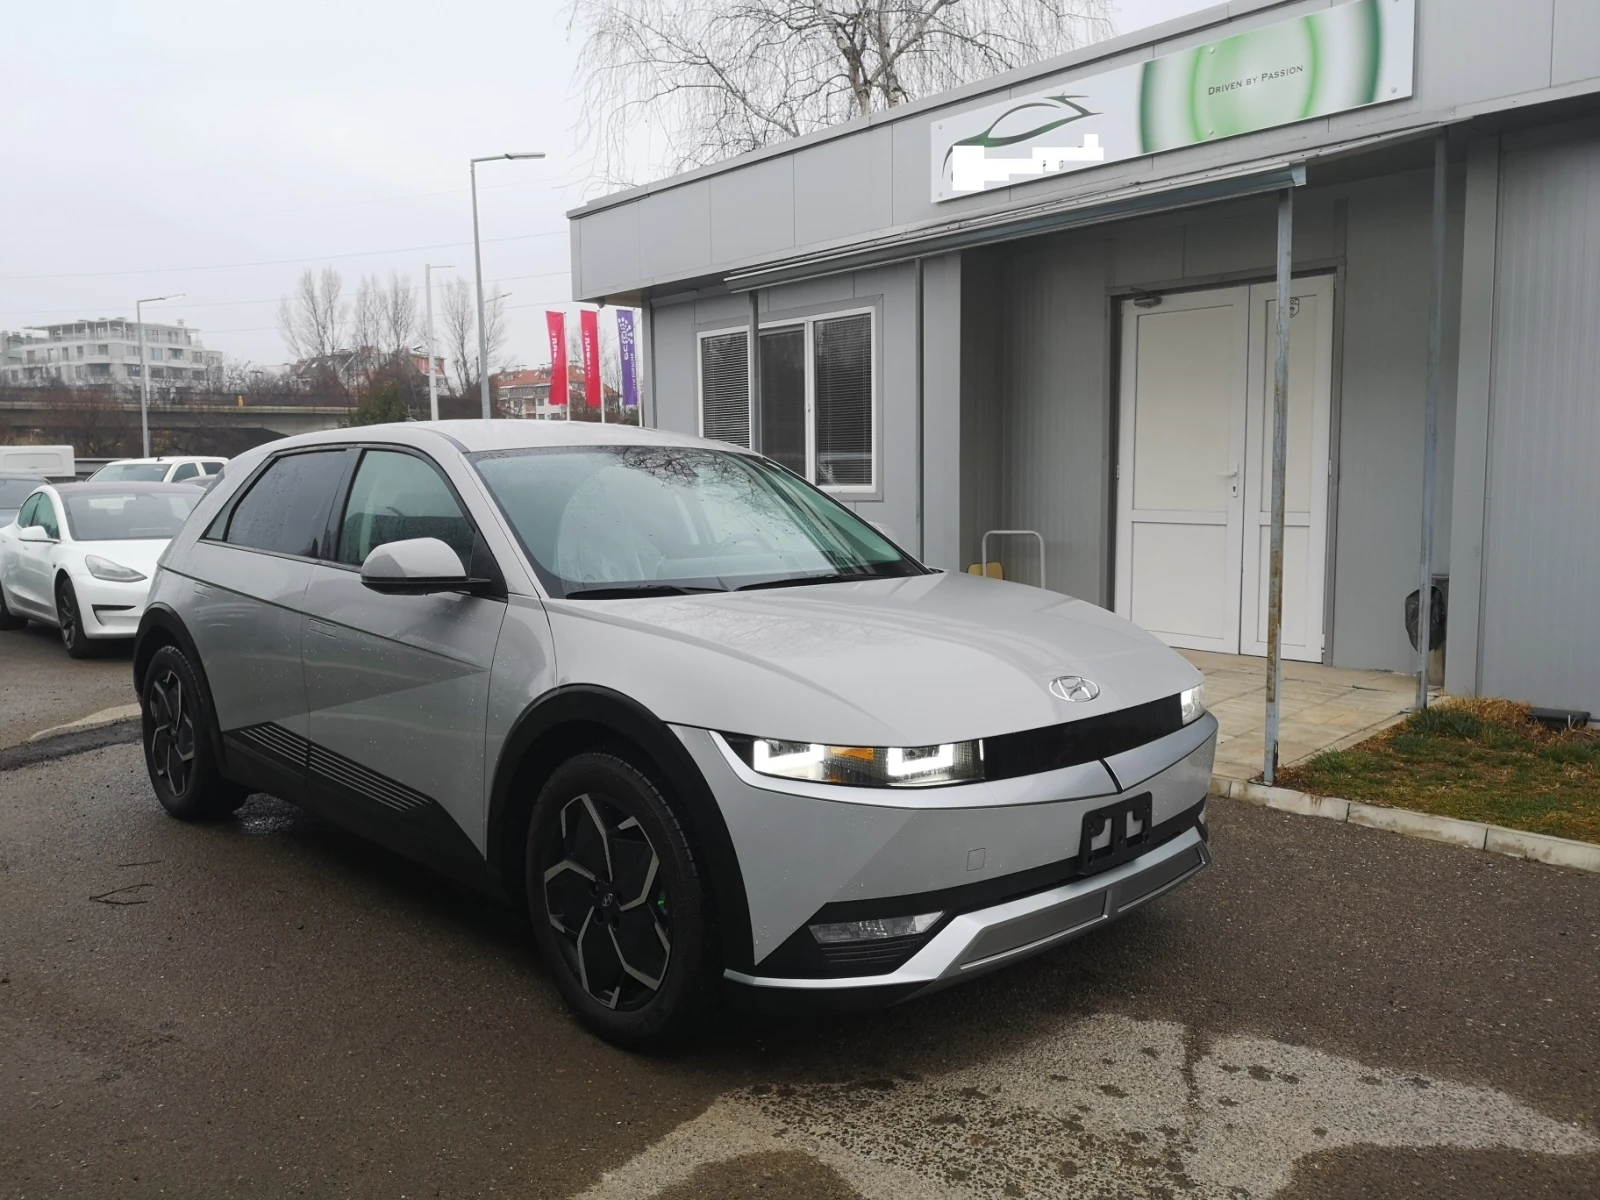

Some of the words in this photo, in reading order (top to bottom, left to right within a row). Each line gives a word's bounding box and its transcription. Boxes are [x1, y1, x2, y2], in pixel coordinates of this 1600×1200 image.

[1208, 80, 1242, 95] DRIVEN
[1246, 76, 1257, 86] BY
[1261, 65, 1303, 82] PASSION
